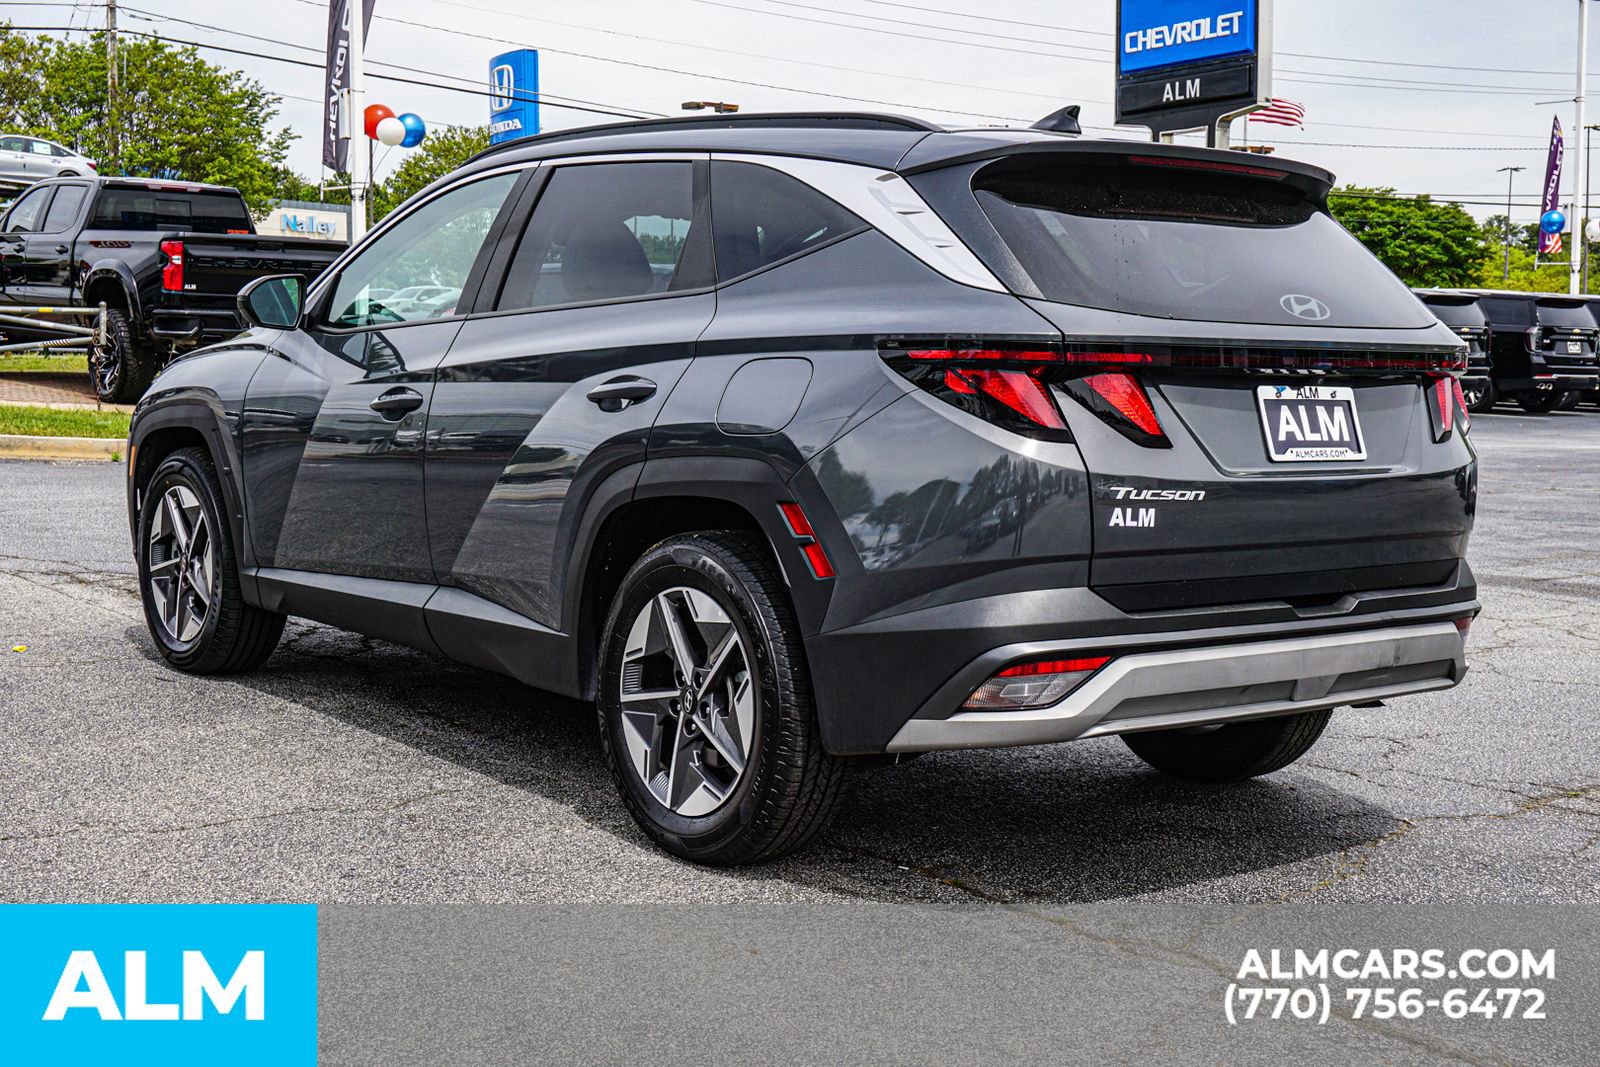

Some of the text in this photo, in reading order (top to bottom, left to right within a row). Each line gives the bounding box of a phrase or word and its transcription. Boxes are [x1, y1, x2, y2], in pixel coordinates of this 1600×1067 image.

[1125, 11, 1243, 53] CHEVROLET
[1162, 78, 1201, 102] ALM
[280, 214, 337, 239] Nalley
[197, 256, 328, 271] CHEVROLE
[1295, 386, 1320, 399] ALM
[1278, 405, 1351, 442] ALM
[1295, 449, 1346, 459] ALMCARS.COM
[1109, 507, 1156, 527] ALM
